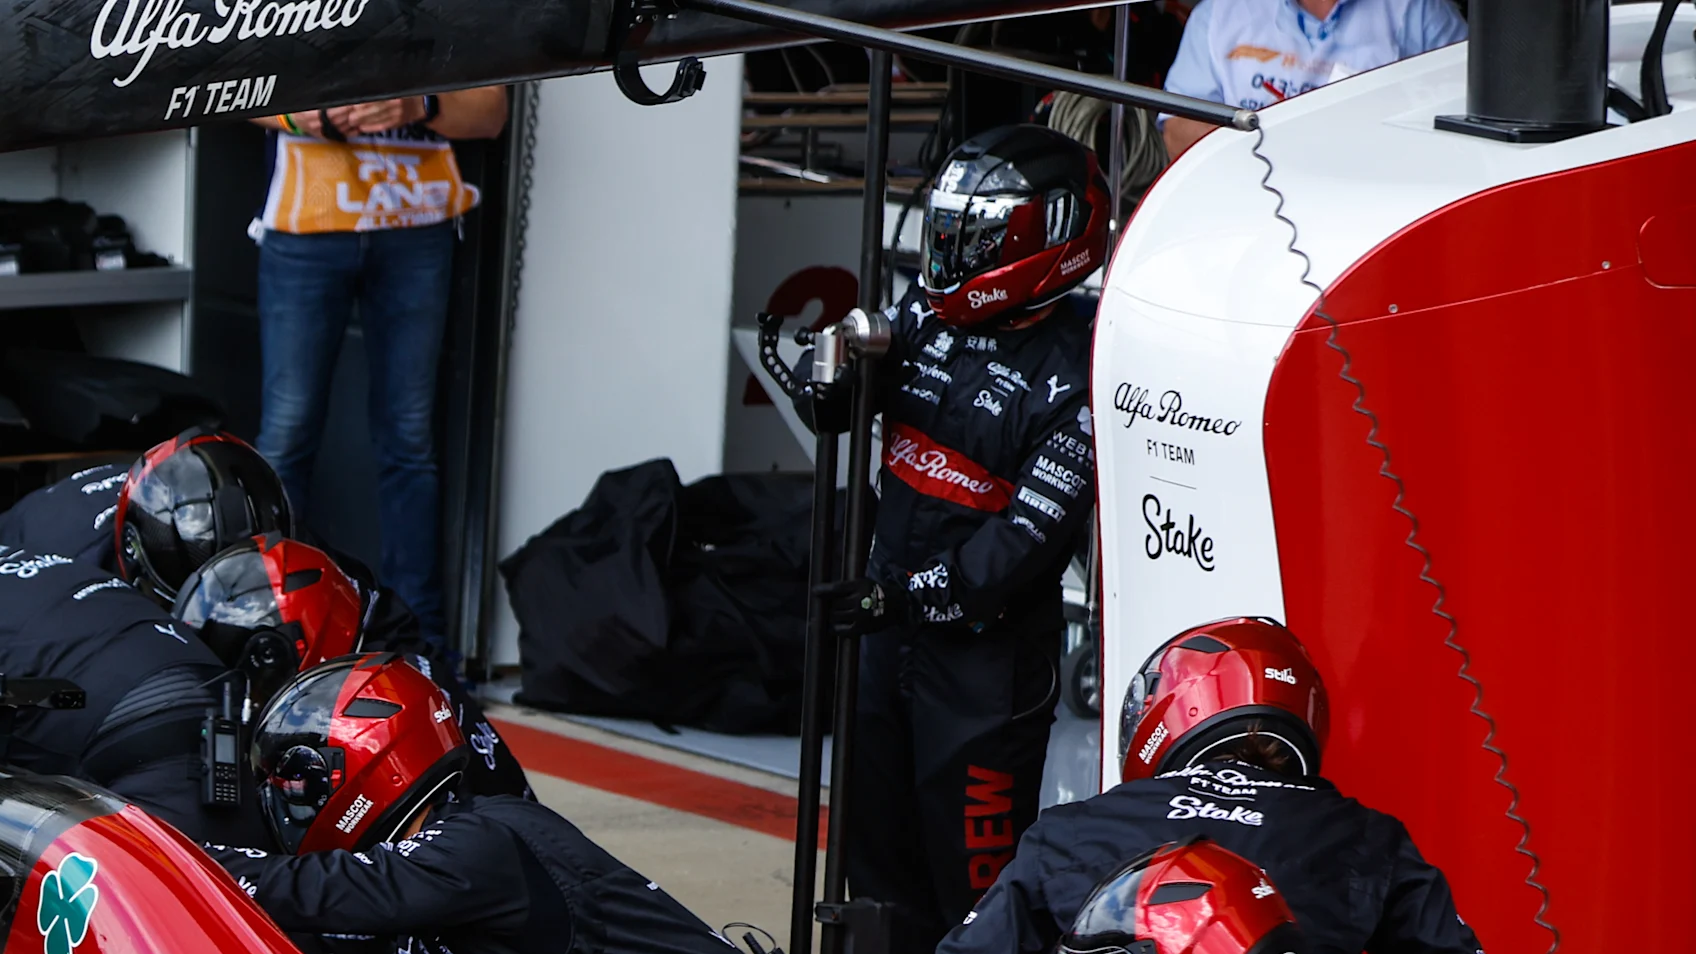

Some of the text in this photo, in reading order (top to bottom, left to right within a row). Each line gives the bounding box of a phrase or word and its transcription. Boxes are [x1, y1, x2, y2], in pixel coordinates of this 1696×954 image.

[91, 0, 206, 87] Alfa
[164, 75, 277, 120] F1 TEAM
[354, 151, 421, 182] PIT
[336, 180, 452, 212] LANE
[1060, 249, 1090, 271] MASCOT
[967, 287, 1008, 309] Stake
[1114, 382, 1242, 435] Alfa Romeo
[1052, 430, 1087, 454] WEB
[1147, 439, 1196, 465] F1 TEAM
[914, 449, 994, 494] Romeo
[1031, 467, 1079, 499] WORKWEAR
[1035, 455, 1087, 490] MASCOT
[1017, 485, 1066, 523] PIRELLI
[1142, 493, 1215, 572] Stake
[1264, 667, 1297, 685] Stilo
[1138, 721, 1166, 761] MASCOT
[1143, 728, 1170, 765] WORKWEAR
[1212, 783, 1258, 795] TEAM
[335, 794, 368, 831] MASCOT
[343, 799, 375, 834] WORKWEAR
[1166, 795, 1265, 826] Stake
[964, 764, 1015, 902] REW
